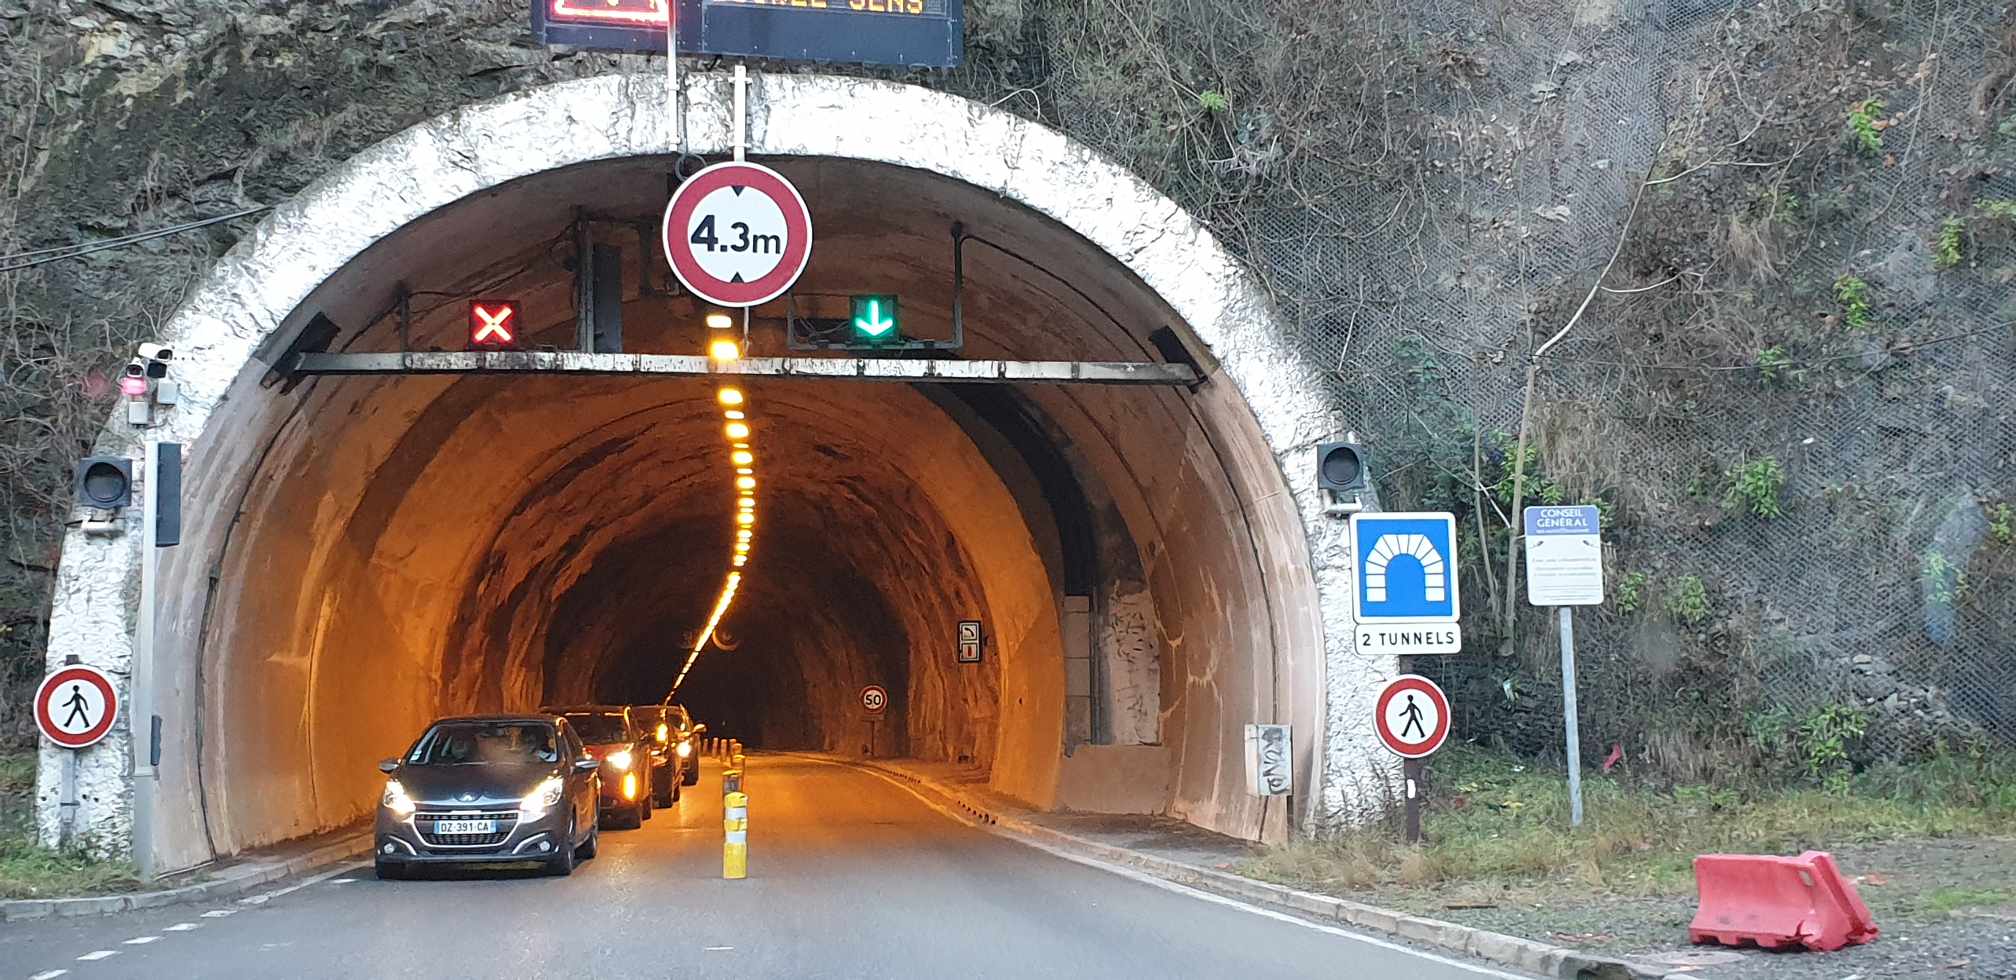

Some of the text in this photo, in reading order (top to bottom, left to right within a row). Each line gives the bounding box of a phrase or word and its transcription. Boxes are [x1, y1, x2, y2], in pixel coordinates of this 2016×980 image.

[690, 214, 781, 254] 4.3m
[1540, 508, 1584, 518] CONSEIL
[1362, 632, 1454, 646] 2 TUNNELS
[865, 694, 881, 706] 50
